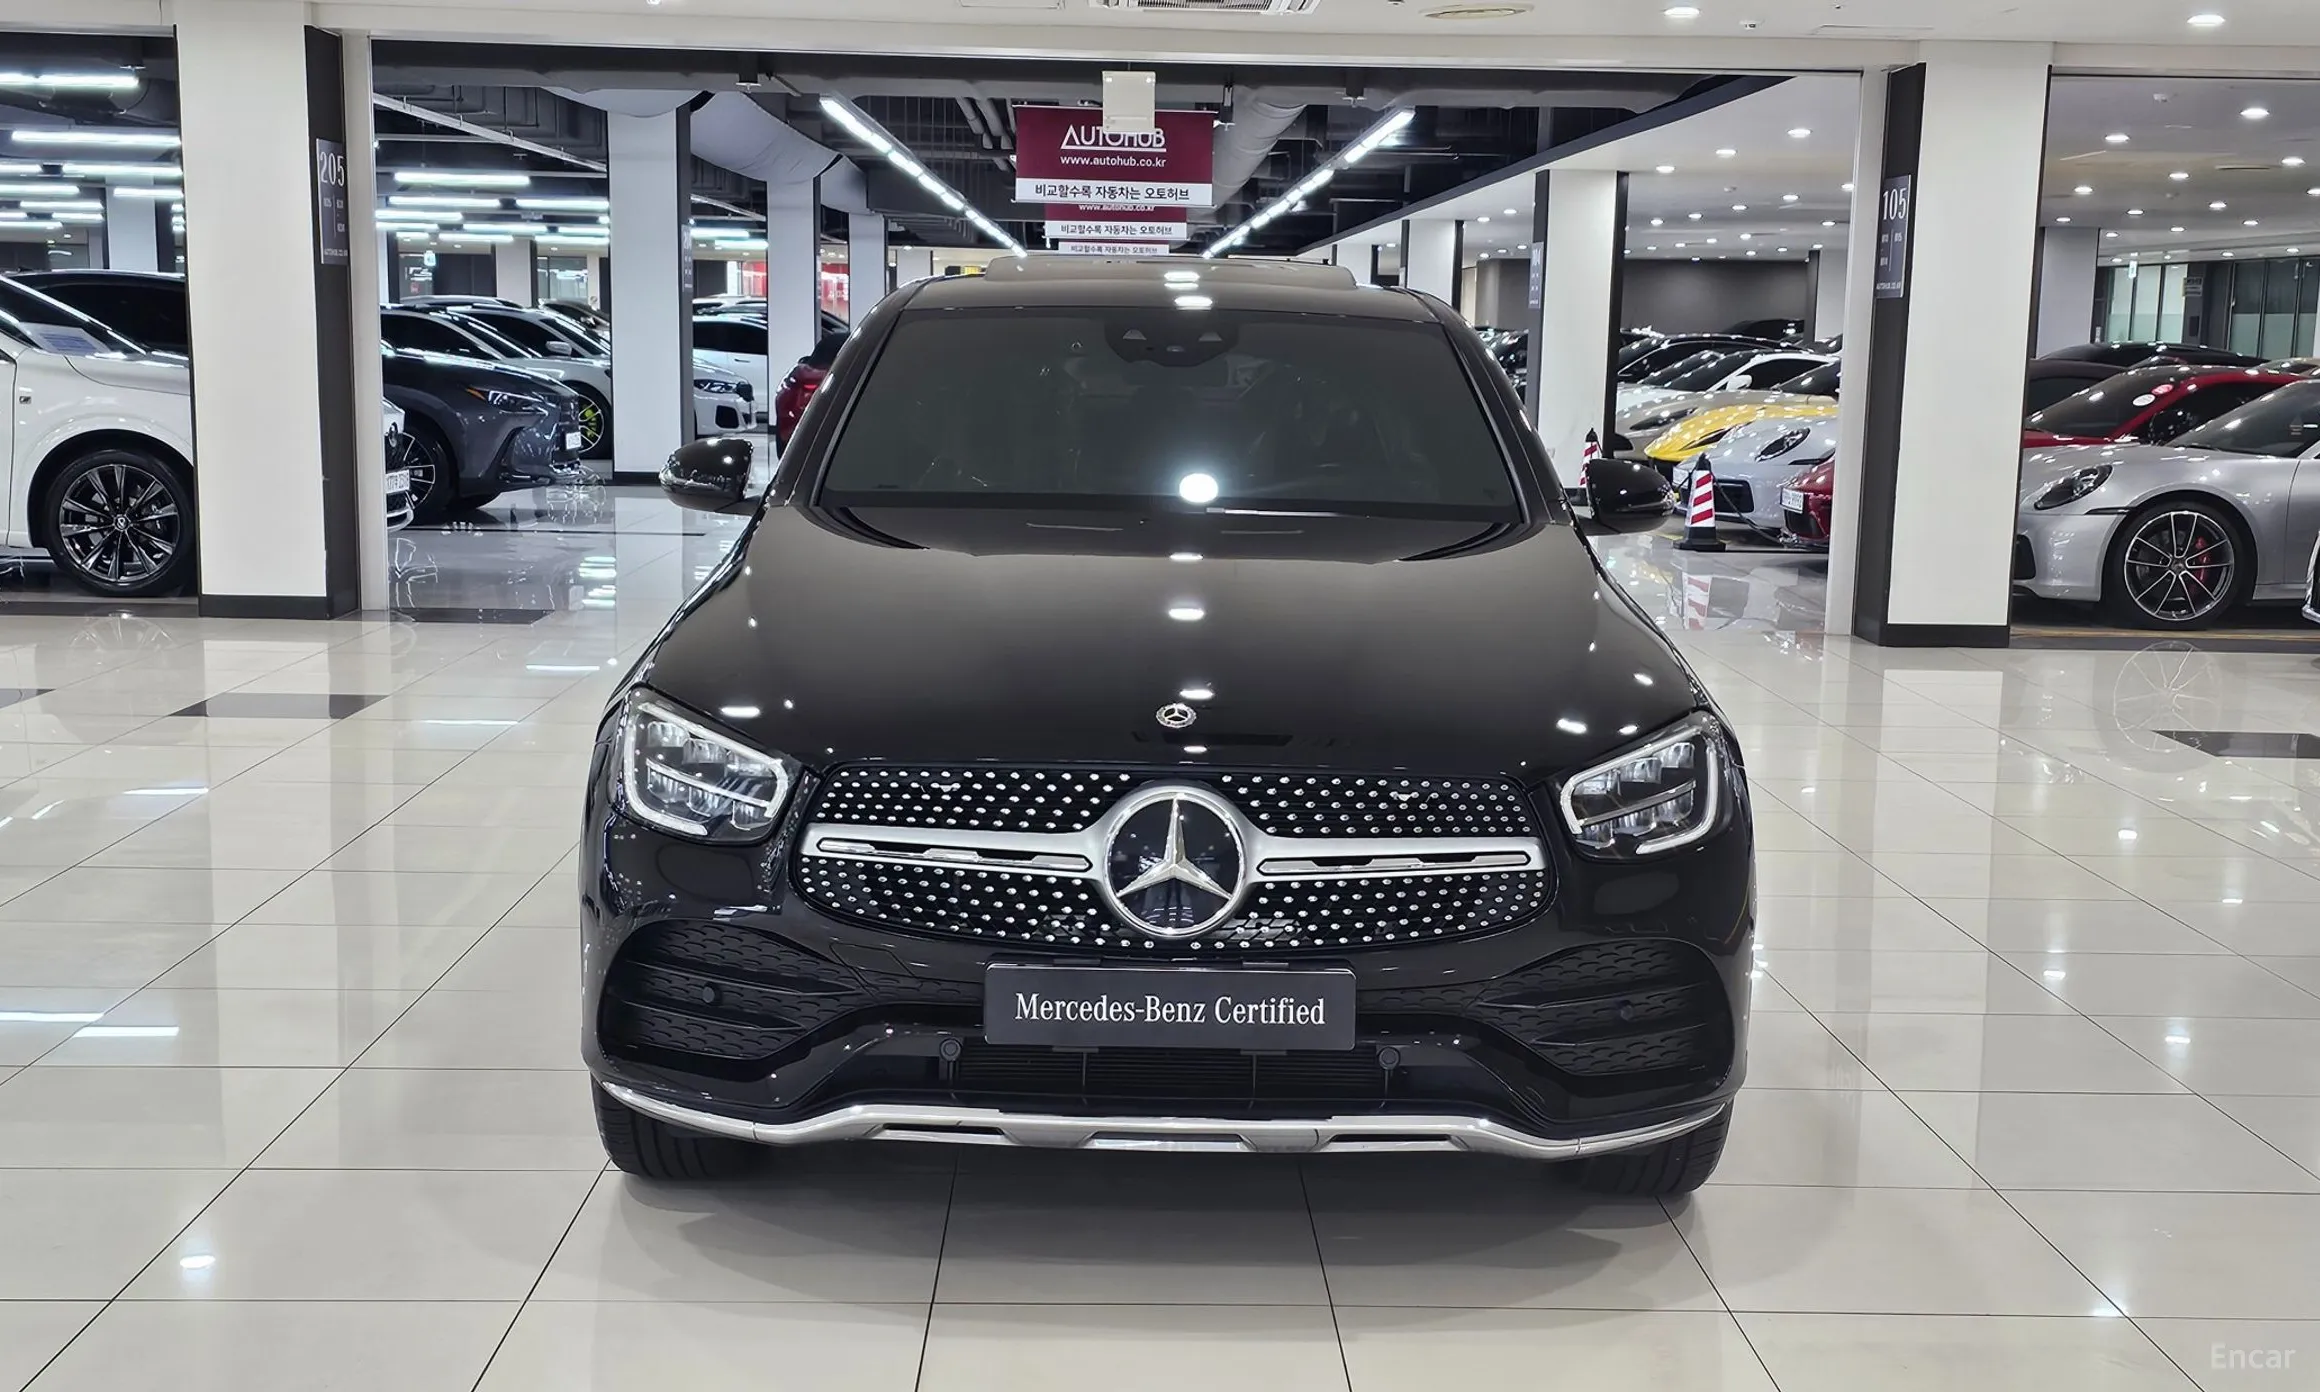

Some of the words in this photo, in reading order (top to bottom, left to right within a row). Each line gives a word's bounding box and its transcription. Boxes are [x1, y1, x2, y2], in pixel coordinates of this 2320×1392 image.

[319, 151, 345, 187] 205
[1060, 155, 1166, 167] www.autohub.co.kr
[1035, 184, 1092, 198] 비교할수록
[1095, 186, 1141, 200] 자동차는
[1144, 187, 1190, 201] 오토허브
[1882, 187, 1907, 221] 105
[1104, 225, 1137, 236] 자동차는
[1139, 225, 1173, 236] 오토허브
[1014, 992, 1206, 1024] Mercedes-Benz
[1214, 995, 1326, 1025] Certified
